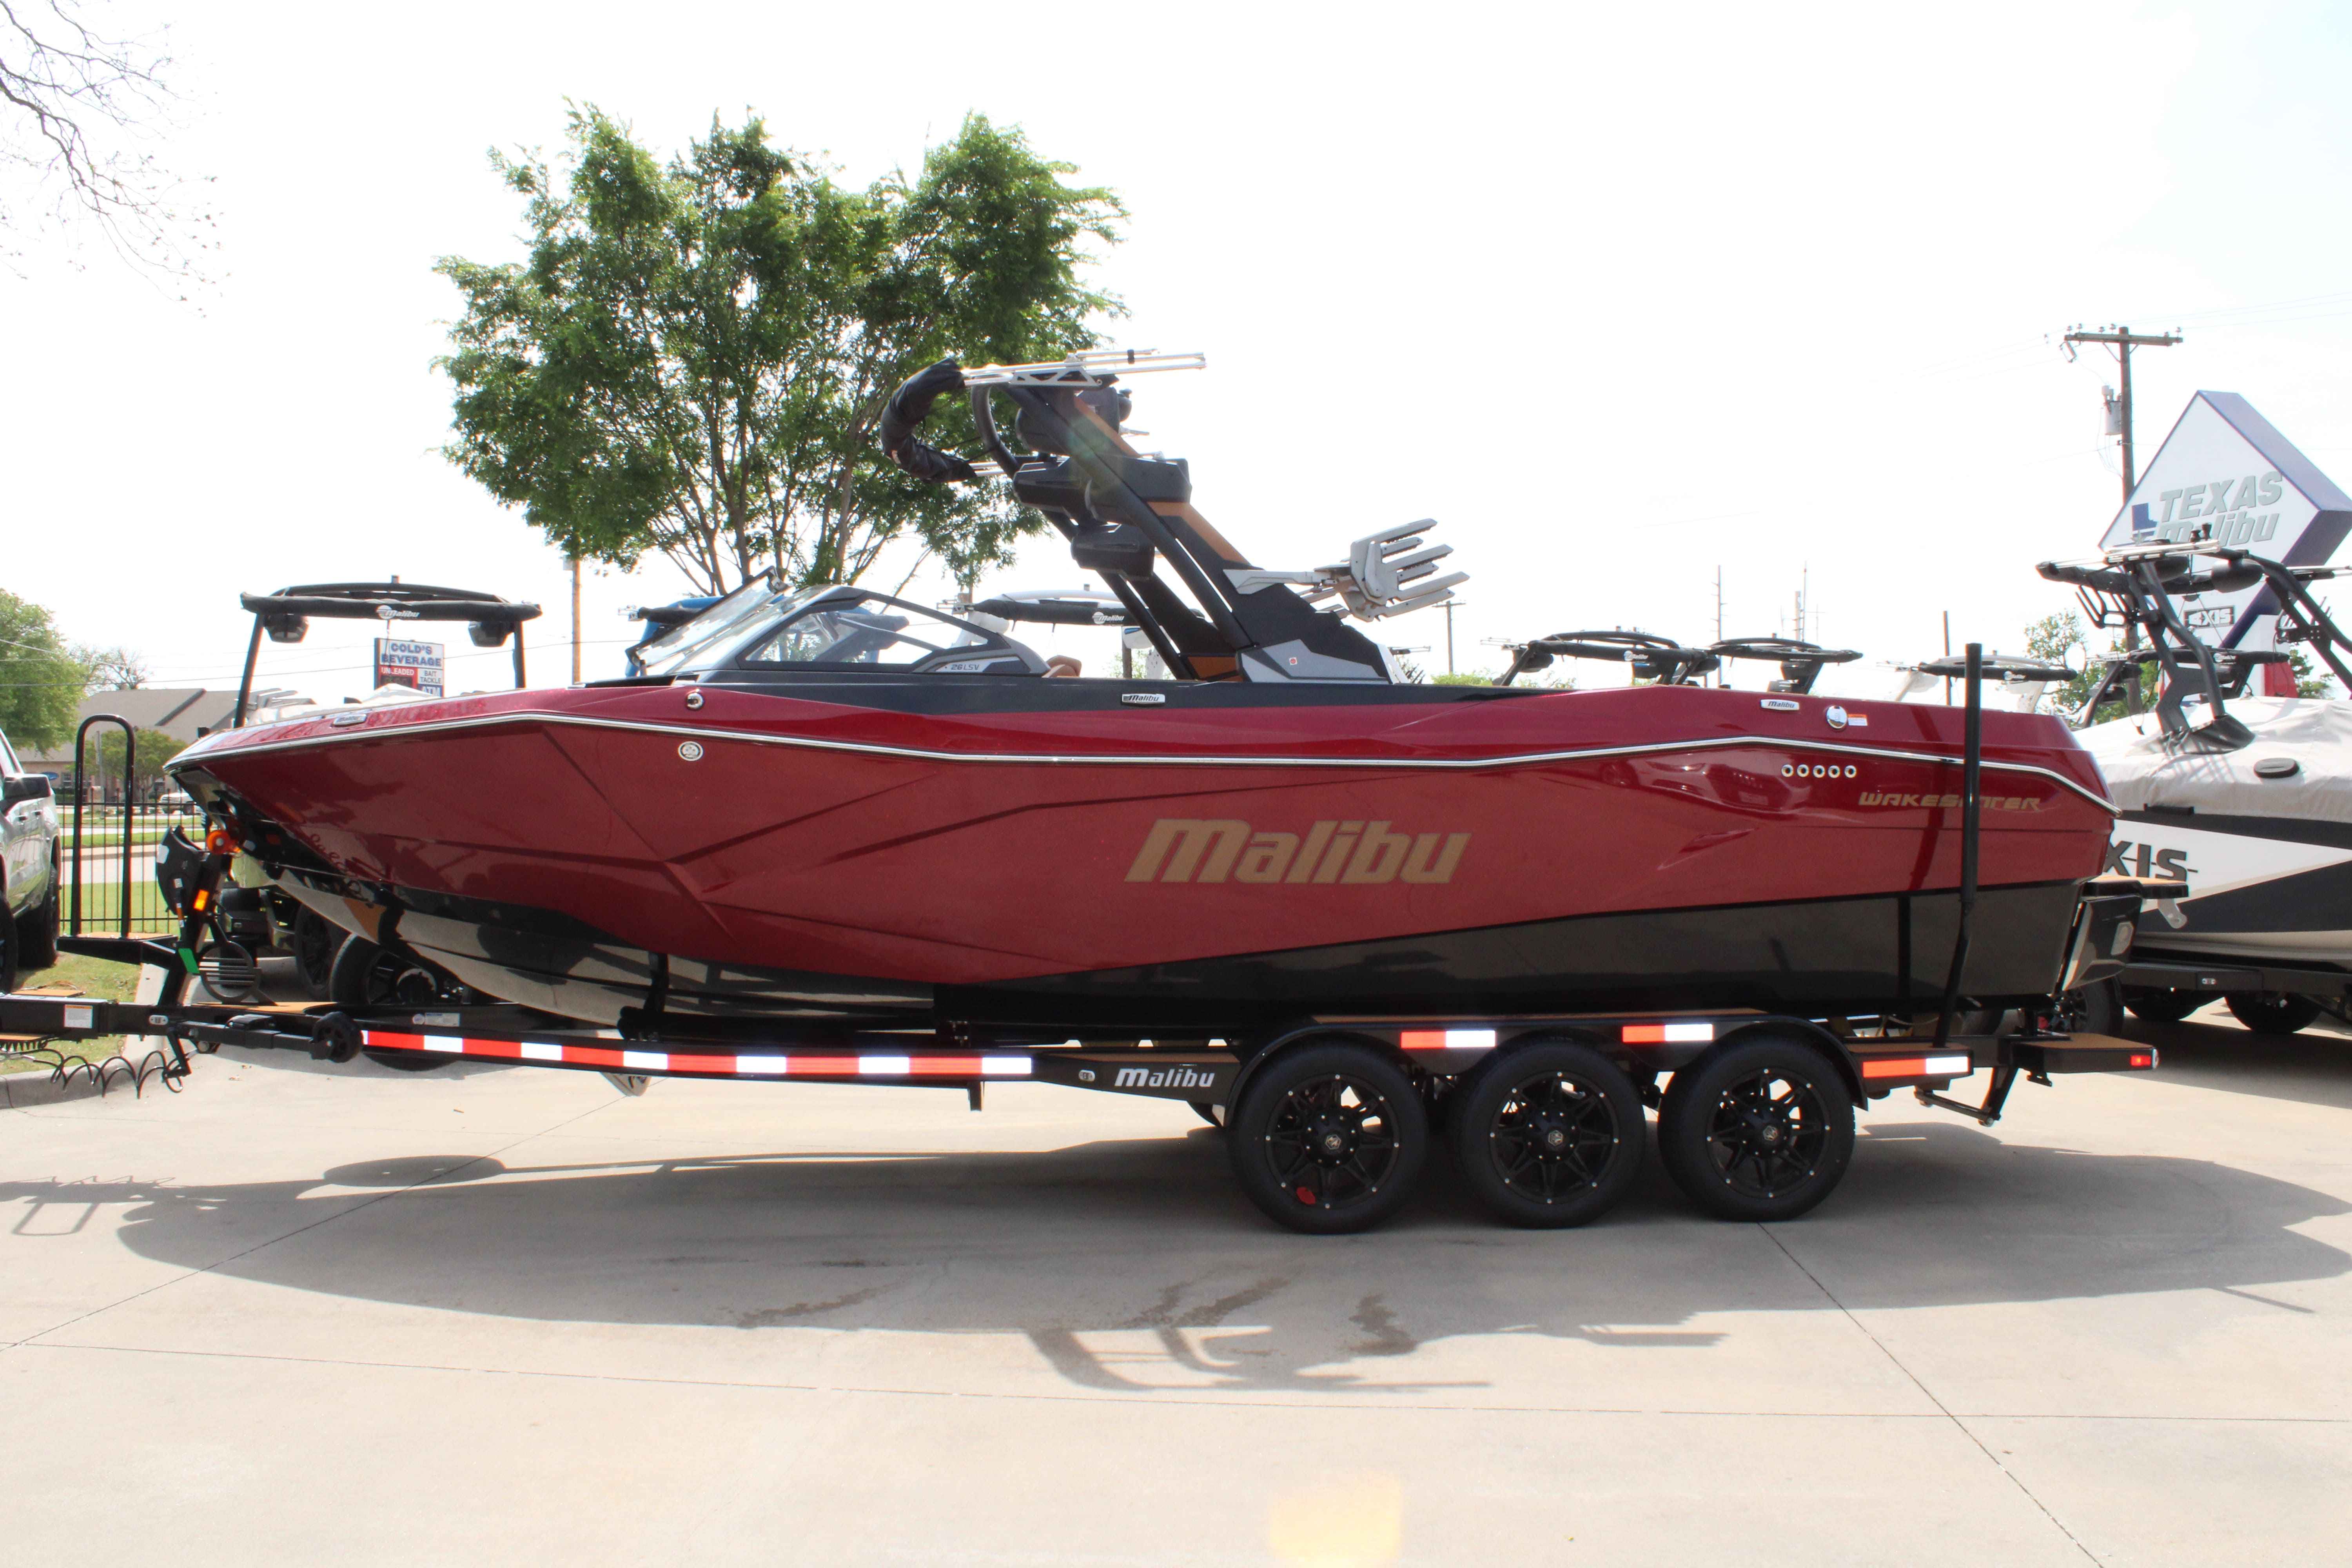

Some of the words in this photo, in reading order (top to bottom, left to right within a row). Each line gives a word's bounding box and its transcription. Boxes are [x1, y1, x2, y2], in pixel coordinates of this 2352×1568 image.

[2160, 471, 2282, 523] TEXAS
[2156, 511, 2279, 547] Mlibu
[381, 653, 441, 666] BEVERAGE
[1858, 792, 2042, 811] WAKESTTER
[1124, 818, 1472, 884] Malibu
[1114, 1068, 1215, 1087] Malibu
